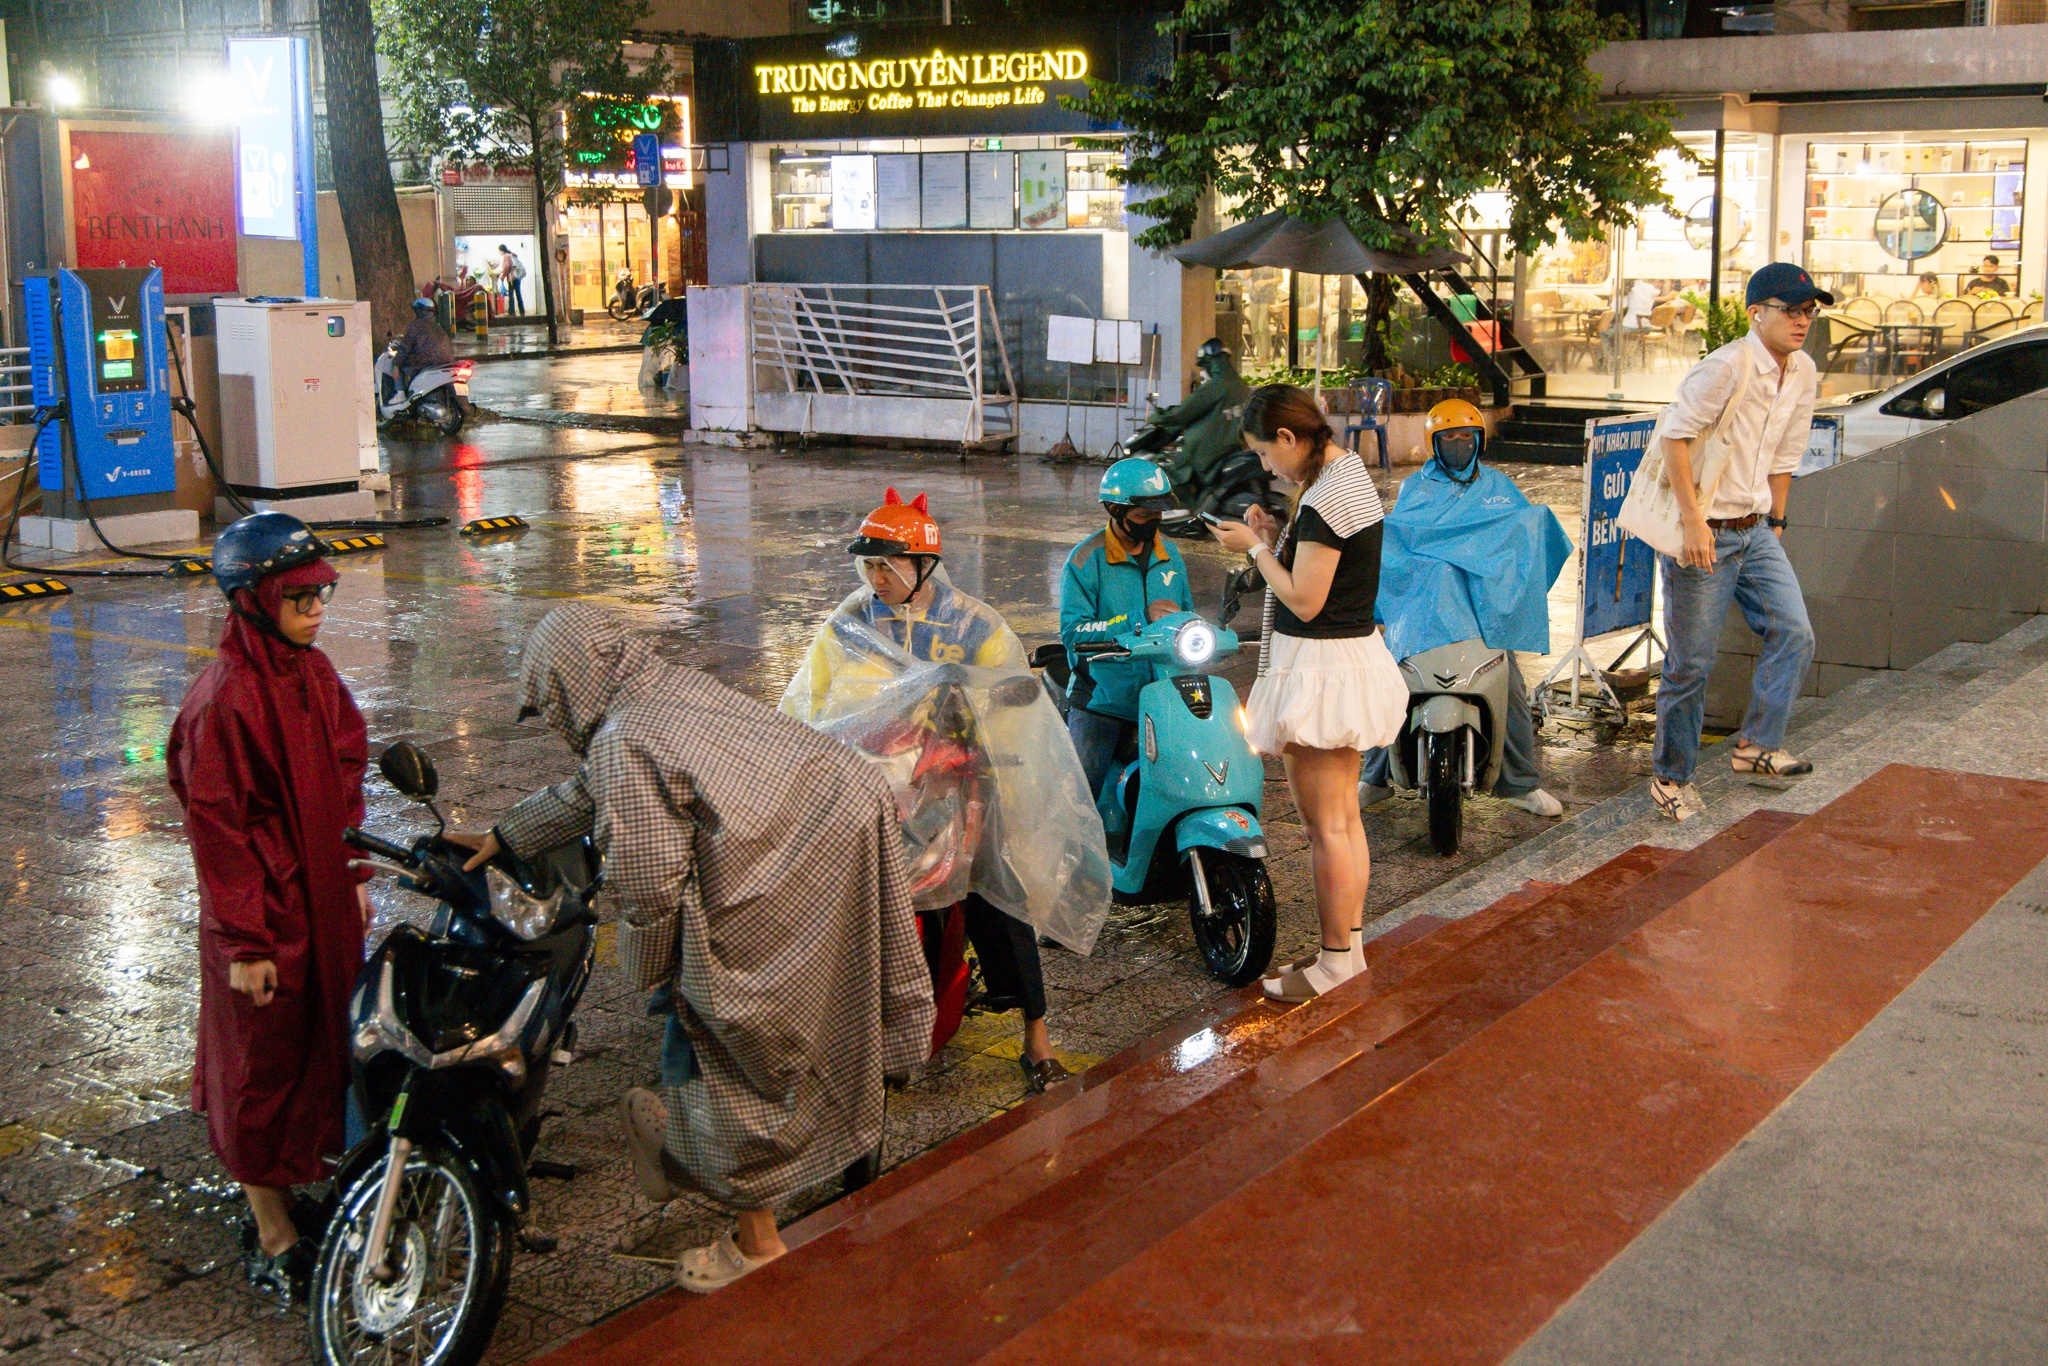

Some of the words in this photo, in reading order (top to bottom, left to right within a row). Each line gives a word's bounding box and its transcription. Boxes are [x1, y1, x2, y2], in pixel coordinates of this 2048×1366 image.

[755, 62, 847, 93] TRUNG
[848, 48, 969, 89] NGUYÊN
[971, 50, 1089, 84] LEGEND
[792, 95, 816, 113] The
[819, 95, 865, 114] Energy
[868, 92, 913, 110] Coffee
[916, 90, 949, 108] That
[951, 89, 1011, 109] Changes
[1013, 86, 1046, 105] Life
[1606, 426, 1630, 452] KHÁCH
[1641, 423, 1654, 450] LÒ
[1603, 461, 1626, 500] GỬI
[930, 634, 965, 664] be
